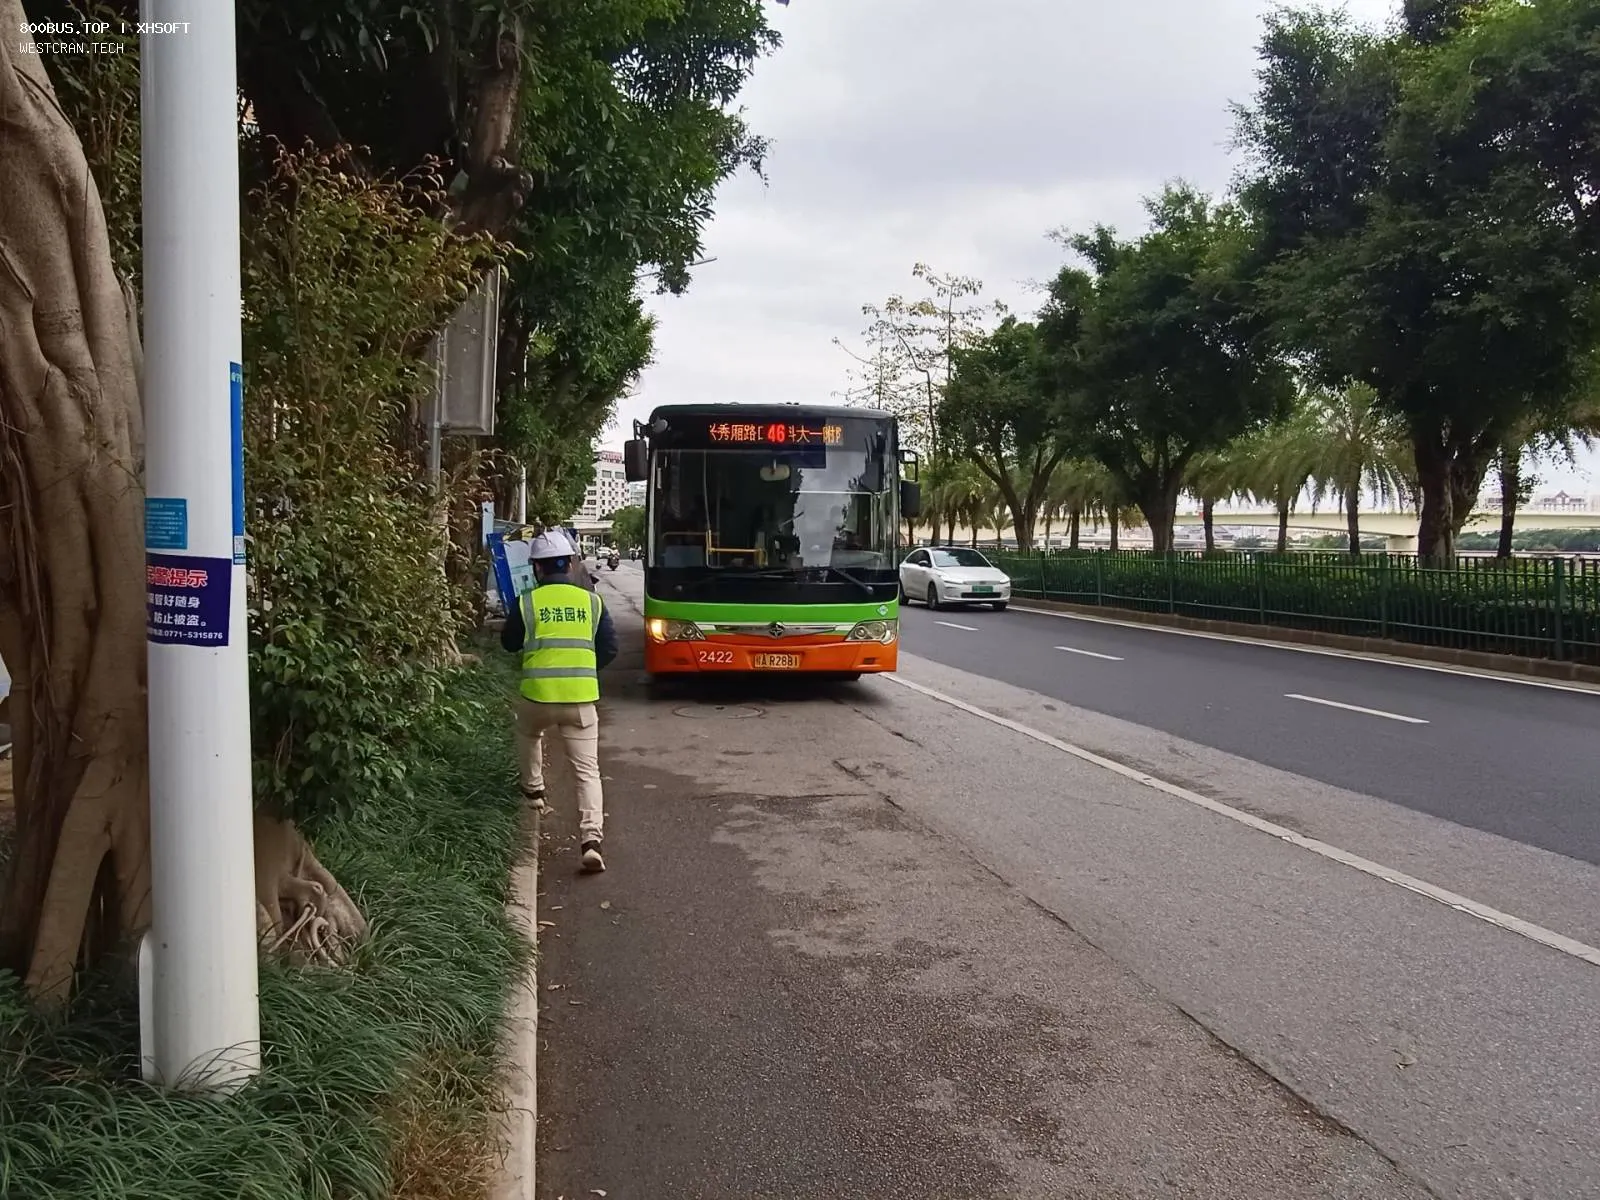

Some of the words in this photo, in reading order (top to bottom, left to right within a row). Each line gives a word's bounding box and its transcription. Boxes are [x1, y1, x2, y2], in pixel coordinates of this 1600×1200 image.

[767, 423, 785, 442] 46
[539, 607, 586, 623] 珍浩园林
[699, 650, 734, 663] 2422
